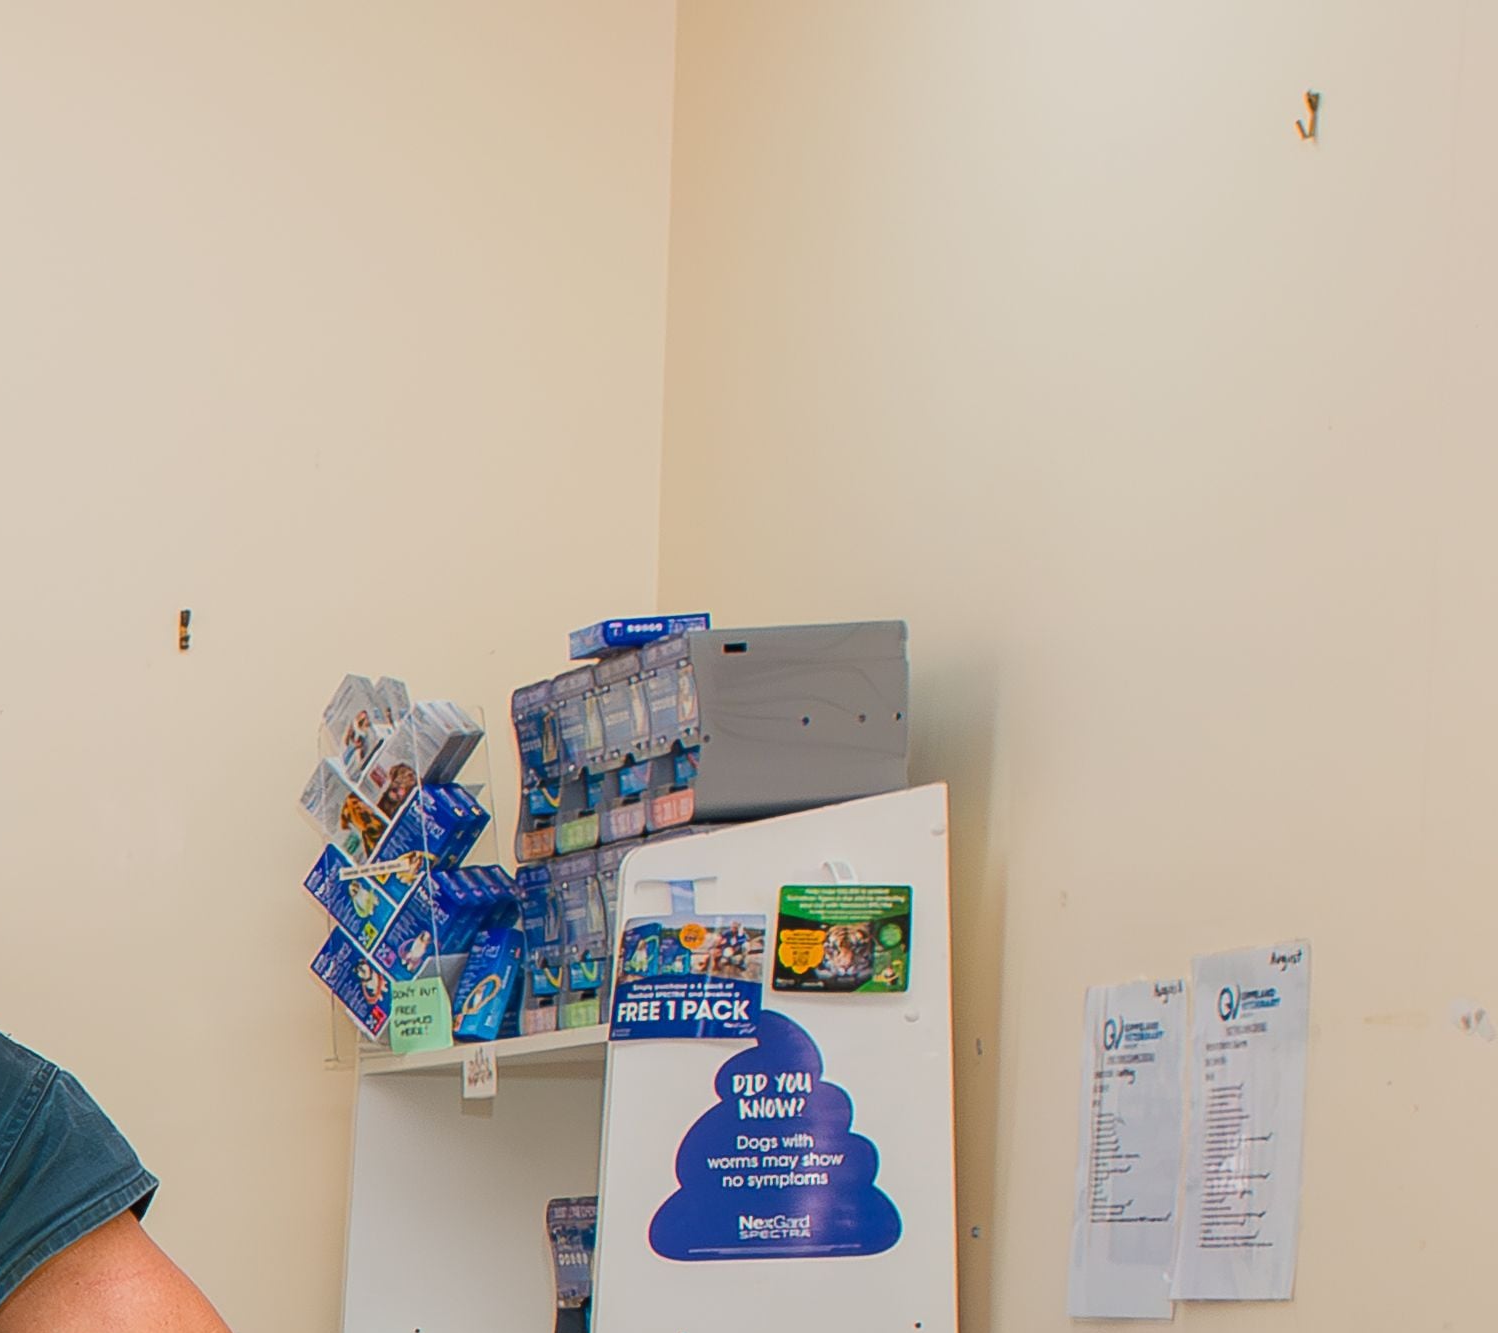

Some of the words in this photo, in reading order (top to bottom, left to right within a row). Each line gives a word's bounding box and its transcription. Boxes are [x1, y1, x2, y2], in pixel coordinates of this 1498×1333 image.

[617, 1001, 661, 1022] FREE
[666, 1000, 676, 1020] 1
[682, 1000, 750, 1021] PACK
[733, 1074, 768, 1096] DID
[775, 1072, 812, 1093] YOU
[739, 1098, 805, 1120] KNOW?
[736, 1135, 778, 1152] Dogs
[782, 1133, 814, 1148] with
[707, 1156, 758, 1170] worms
[762, 1155, 798, 1173] may
[801, 1152, 844, 1167] show
[722, 1175, 744, 1188] no
[747, 1172, 829, 1189] symptoms
[739, 1215, 810, 1231] NexGard
[739, 1231, 811, 1240] SPECTRA
